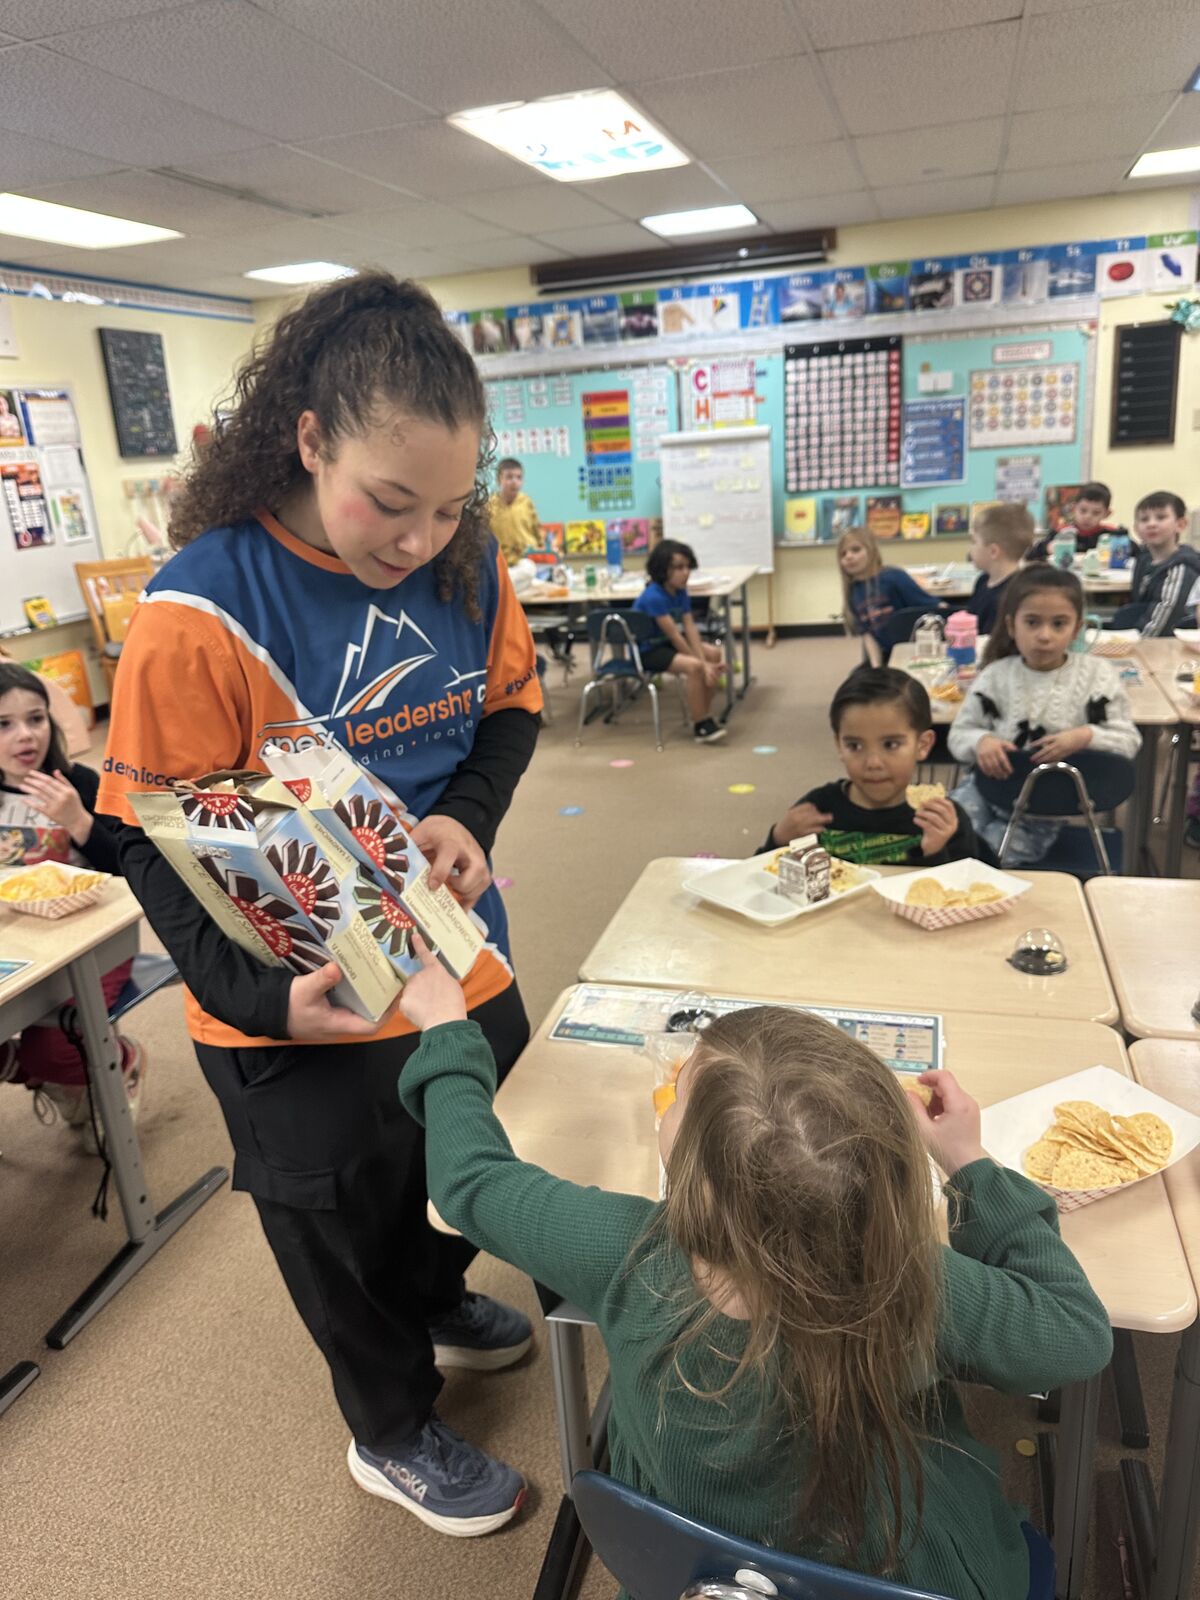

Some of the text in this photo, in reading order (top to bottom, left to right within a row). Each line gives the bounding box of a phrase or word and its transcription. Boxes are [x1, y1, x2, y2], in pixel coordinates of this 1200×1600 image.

[356, 828, 377, 841] STONE
[287, 874, 311, 886] STONE
[383, 1460, 429, 1502] HOKA
